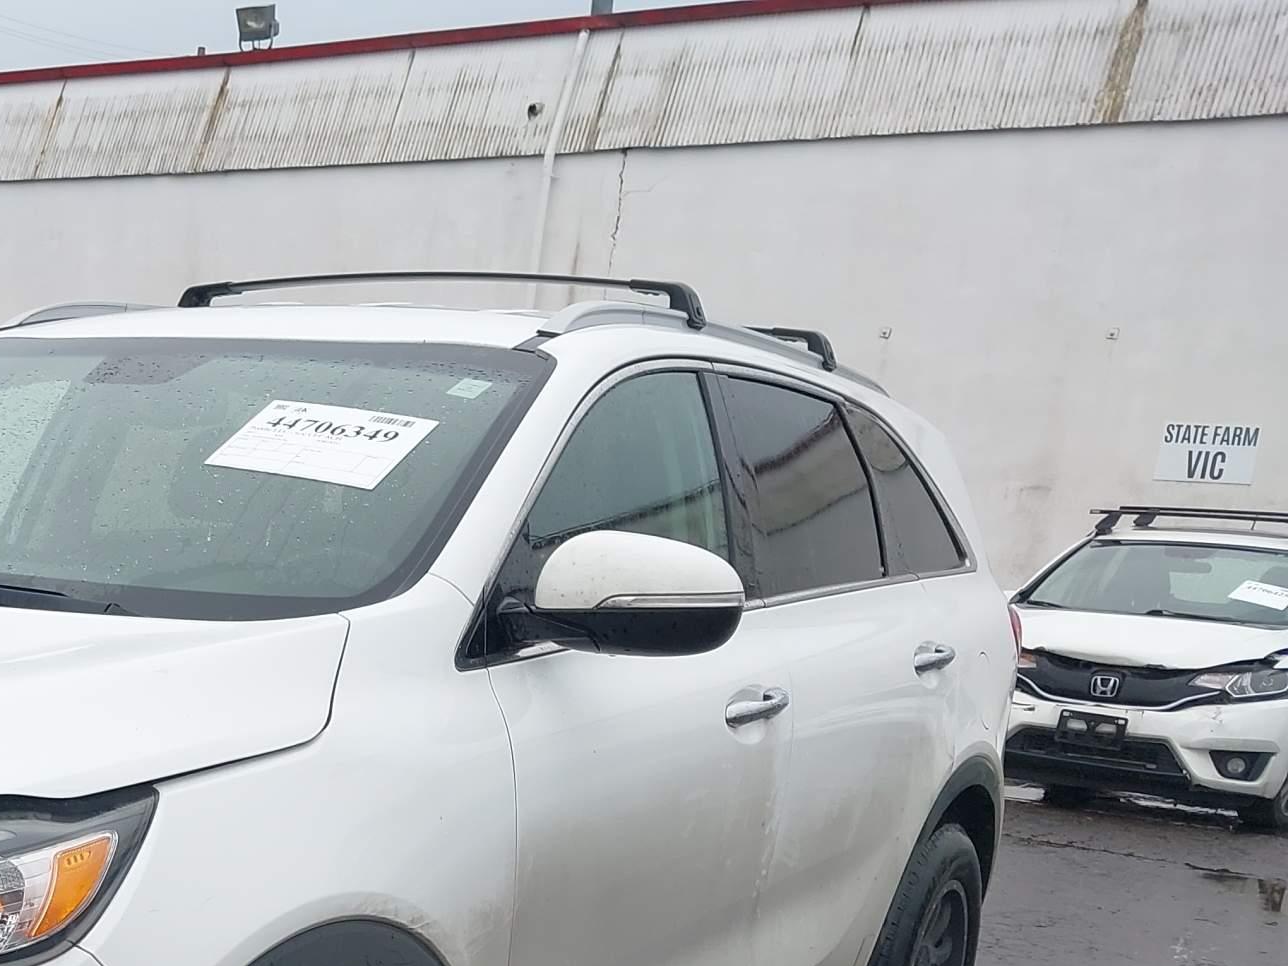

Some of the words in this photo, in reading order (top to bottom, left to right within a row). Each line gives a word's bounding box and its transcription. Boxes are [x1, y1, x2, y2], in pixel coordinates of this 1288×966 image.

[267, 416, 399, 442] 44706349
[1164, 424, 1210, 444] STATE
[1212, 426, 1260, 447] FARM
[1187, 450, 1227, 480] VIC
